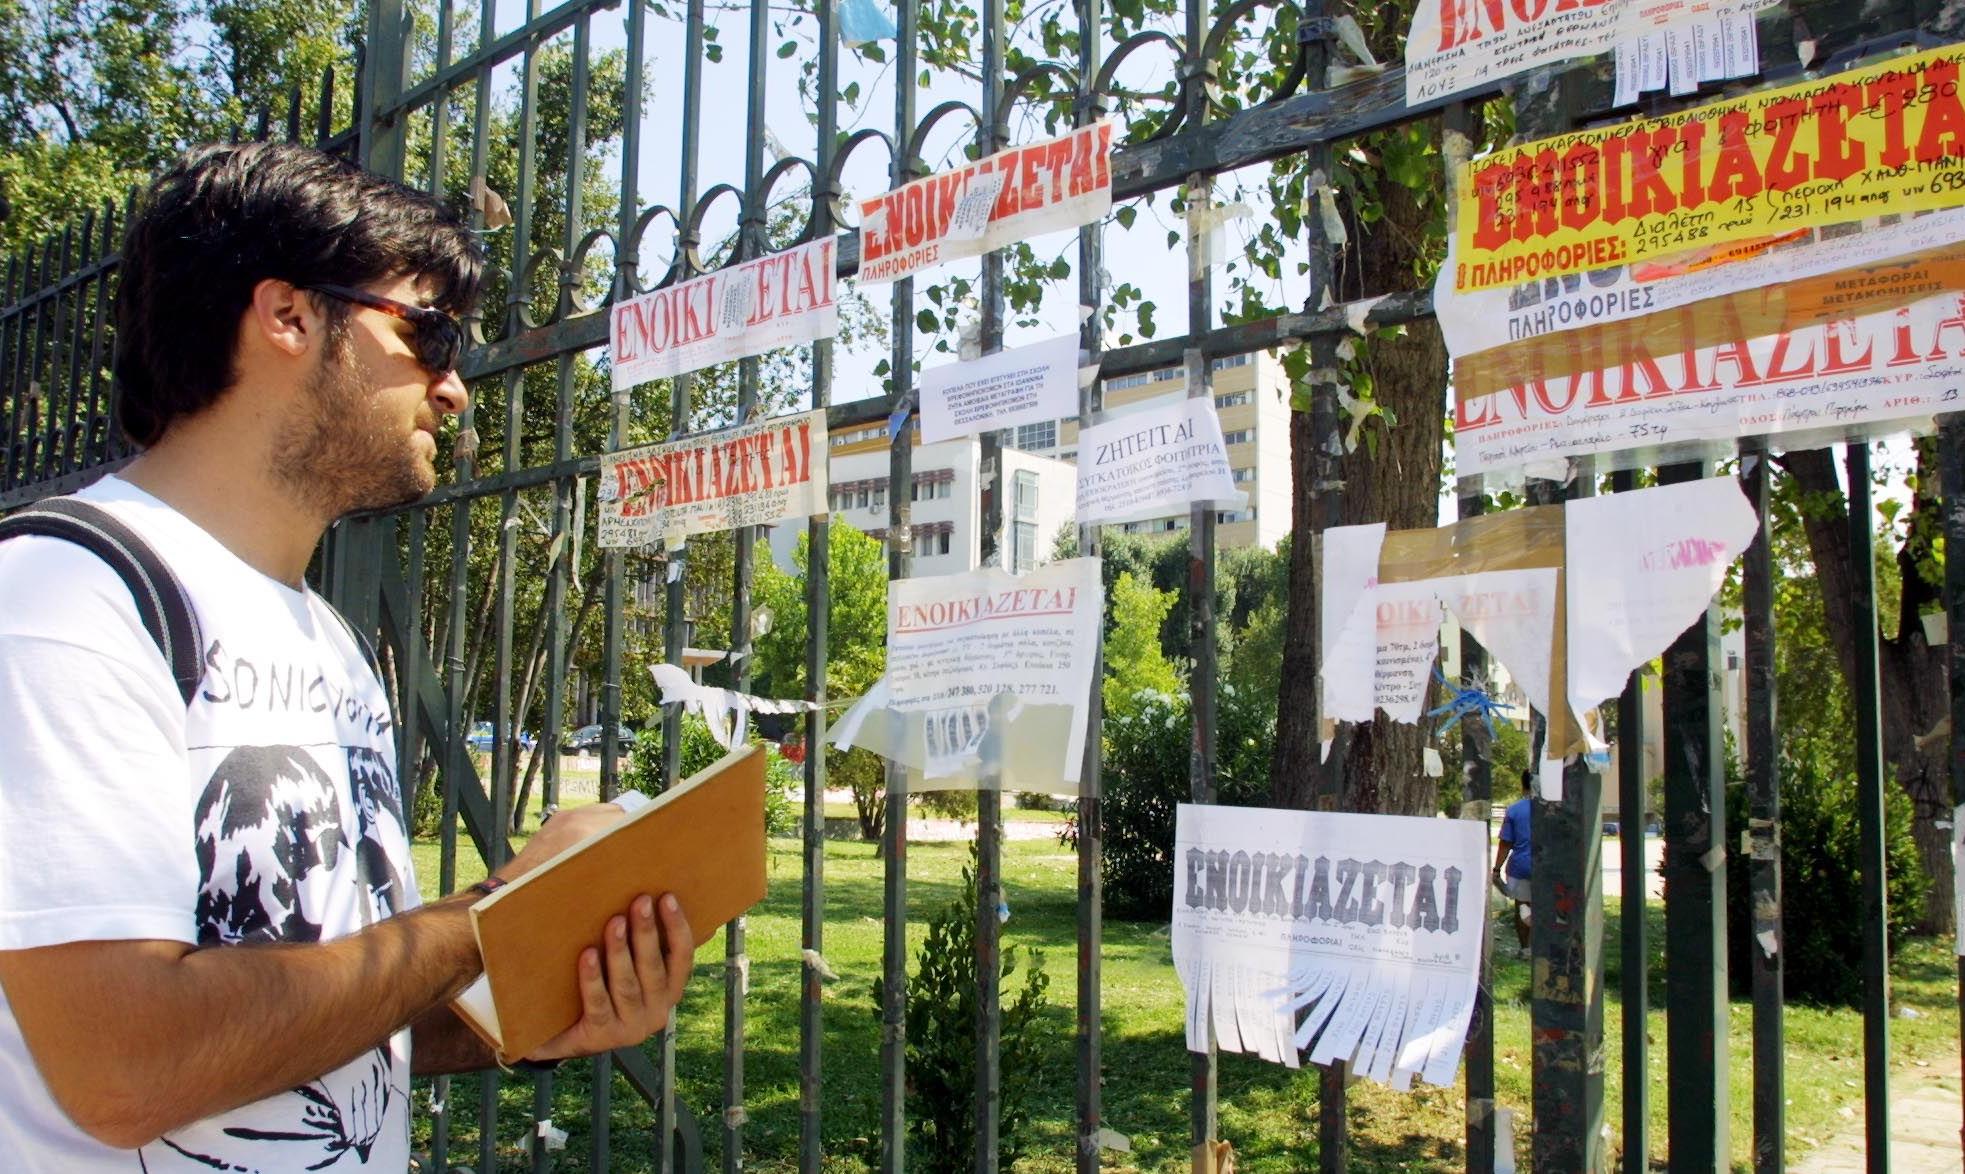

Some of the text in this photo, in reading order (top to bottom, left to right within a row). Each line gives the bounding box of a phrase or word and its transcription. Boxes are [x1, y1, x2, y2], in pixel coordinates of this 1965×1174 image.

[1902, 82, 1958, 107] 280
[861, 124, 1111, 262] ΕΝΟΙΚΖΕΤΑΙ
[861, 244, 940, 281] ΠΛΗΡΟΦΟΡΙΕΣ
[1471, 235, 1627, 288] ΠΛΗΡΟΦΟΡΙΕΣ:
[1636, 226, 1709, 254] 295488
[1509, 286, 1656, 341] ΠΛΗΡΟΦΟΡΙΕΣ
[1096, 418, 1195, 466] ΖΗΤΕΙΤΑΙ
[1154, 443, 1221, 466] ΦΟΙΤΗΤΡΙΑ
[896, 586, 1078, 628] ΕΝΟΙΚΙΑΖΕΤΑΙ
[203, 639, 326, 712] SONIC
[1185, 847, 1463, 935] ΕΝΟΙΚΙΑΖΕΤΑΙ
